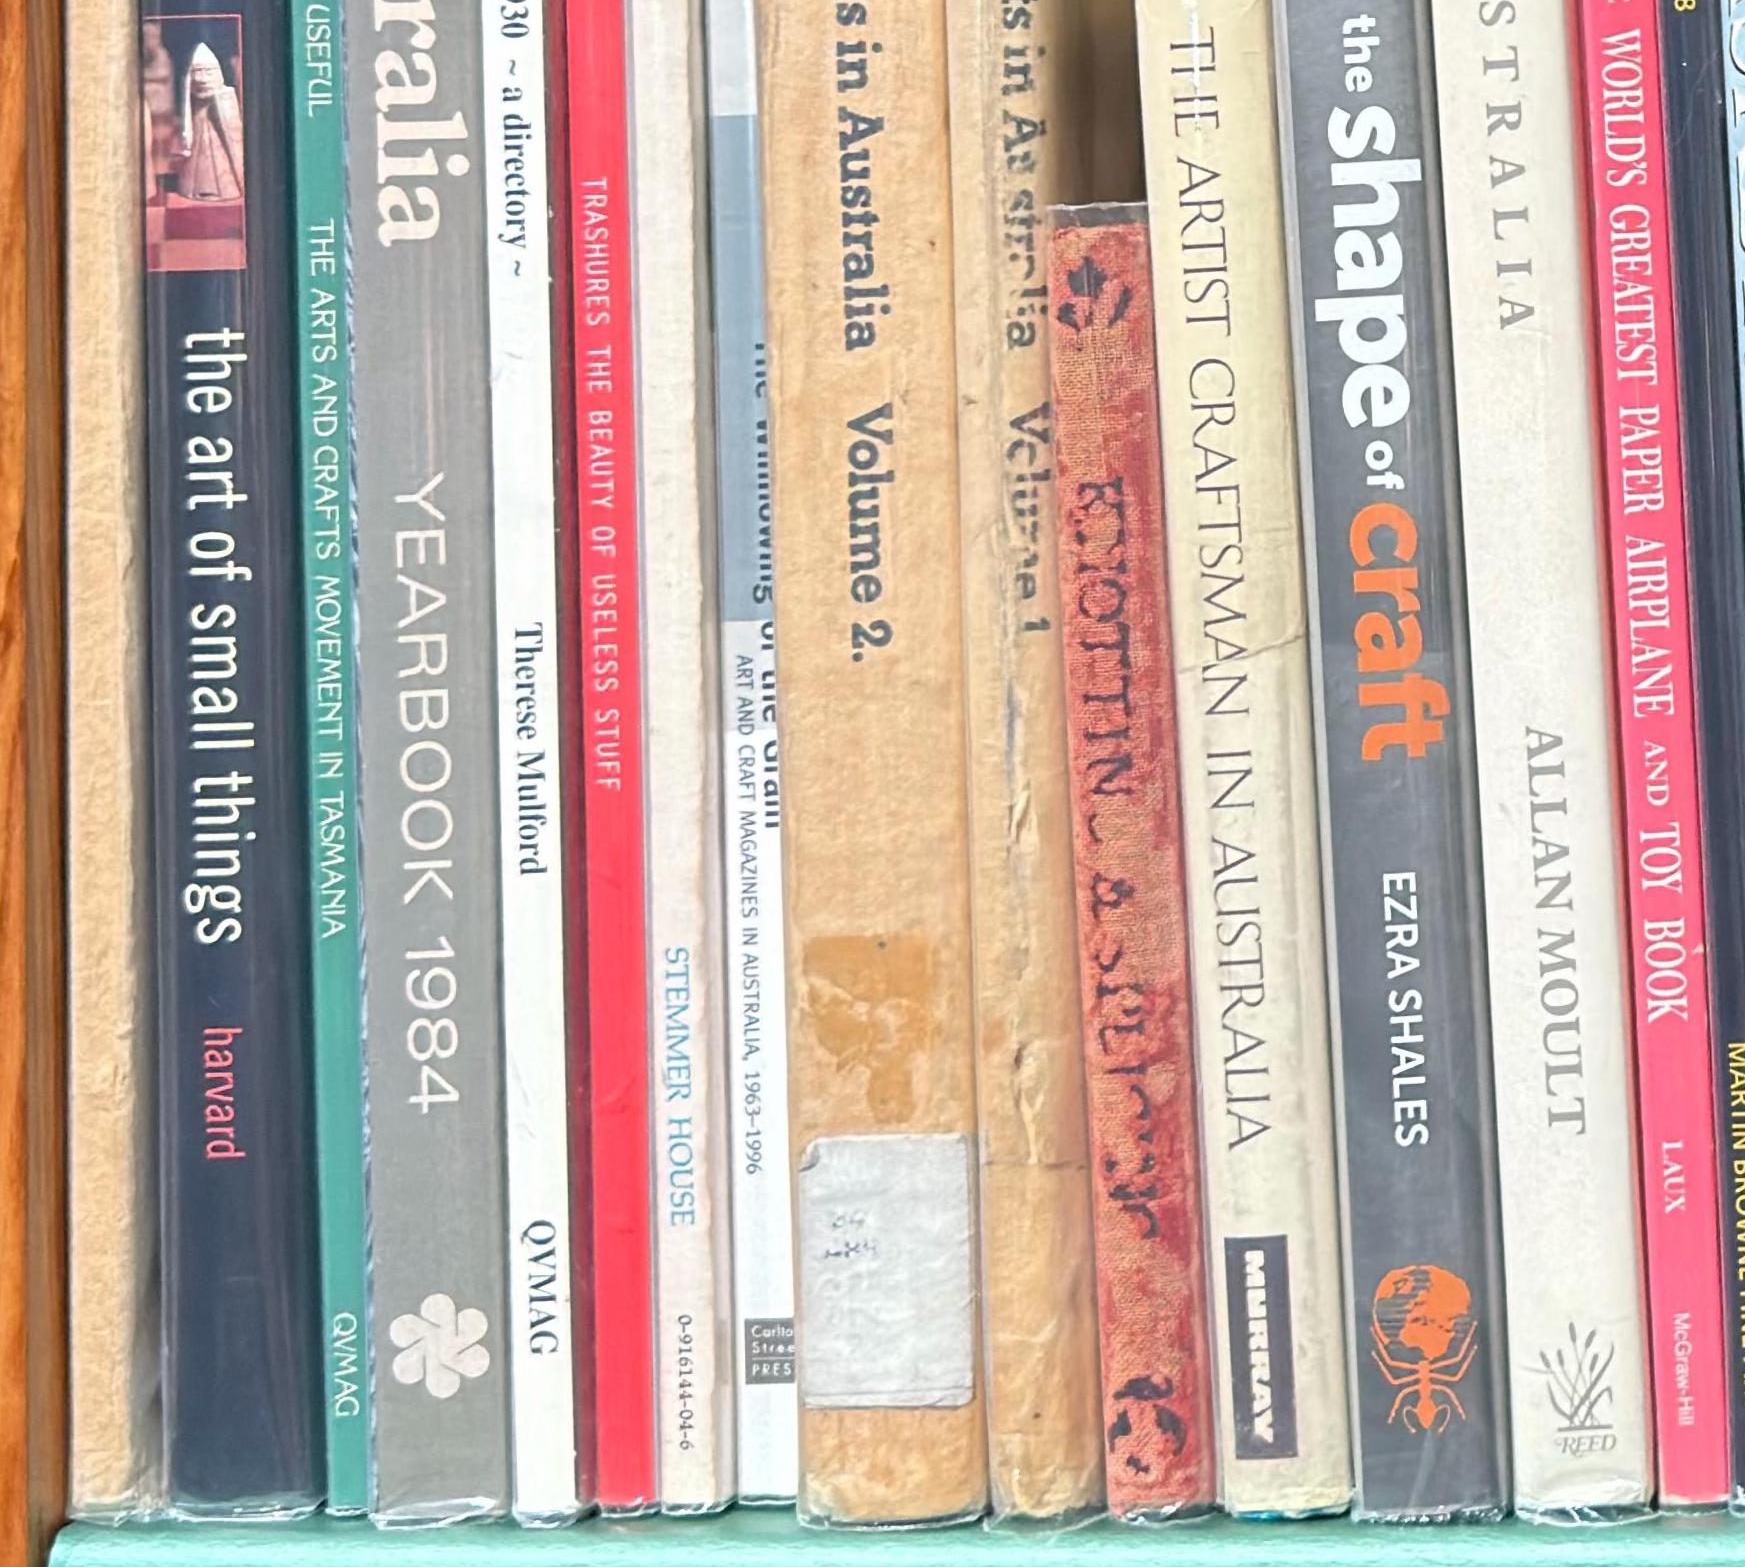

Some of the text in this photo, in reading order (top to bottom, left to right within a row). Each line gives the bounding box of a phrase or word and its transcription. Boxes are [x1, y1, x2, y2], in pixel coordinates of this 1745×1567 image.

[304, 4, 335, 118] USEFUL
[496, 112, 532, 249] directory
[837, 106, 891, 352] Australia
[581, 176, 623, 793] TRASHURES BEAUTY USELESS STUFF
[847, 403, 897, 604] Volume
[1314, 106, 1451, 762] shape craft
[184, 436, 257, 946] art small things
[310, 287, 347, 940] ARTS CRAFTS MOVEMENT TASMANIA
[850, 620, 894, 664] 2.
[1178, 156, 1273, 1152] ARTIST CRAFTSMAN AUSTRALIA
[1608, 202, 1690, 1024] GREATEST PAPER AIRPLANE TOY BOOK
[394, 473, 460, 1116] YEARBOOK 1984
[514, 623, 549, 876] Therese Mulford
[736, 655, 761, 1062] ART CRAFT MAGAZINES AUSTRALIA,
[1381, 871, 1431, 1149] EZRA SHALES
[1525, 725, 1588, 1137] ALLAN MOULT
[203, 1027, 246, 1160] harvard
[664, 946, 696, 1227] STEMMER HOUSE
[1661, 1140, 1686, 1215] LAUX
[331, 1312, 360, 1418] QVMAG
[521, 1219, 559, 1357] QVMAG
[676, 1314, 696, 1451] 0-916144-04-6
[1243, 1249, 1276, 1443] MURRAY
[1671, 1311, 1695, 1427] McGraw-Hill
[1554, 1435, 1618, 1456] REED
